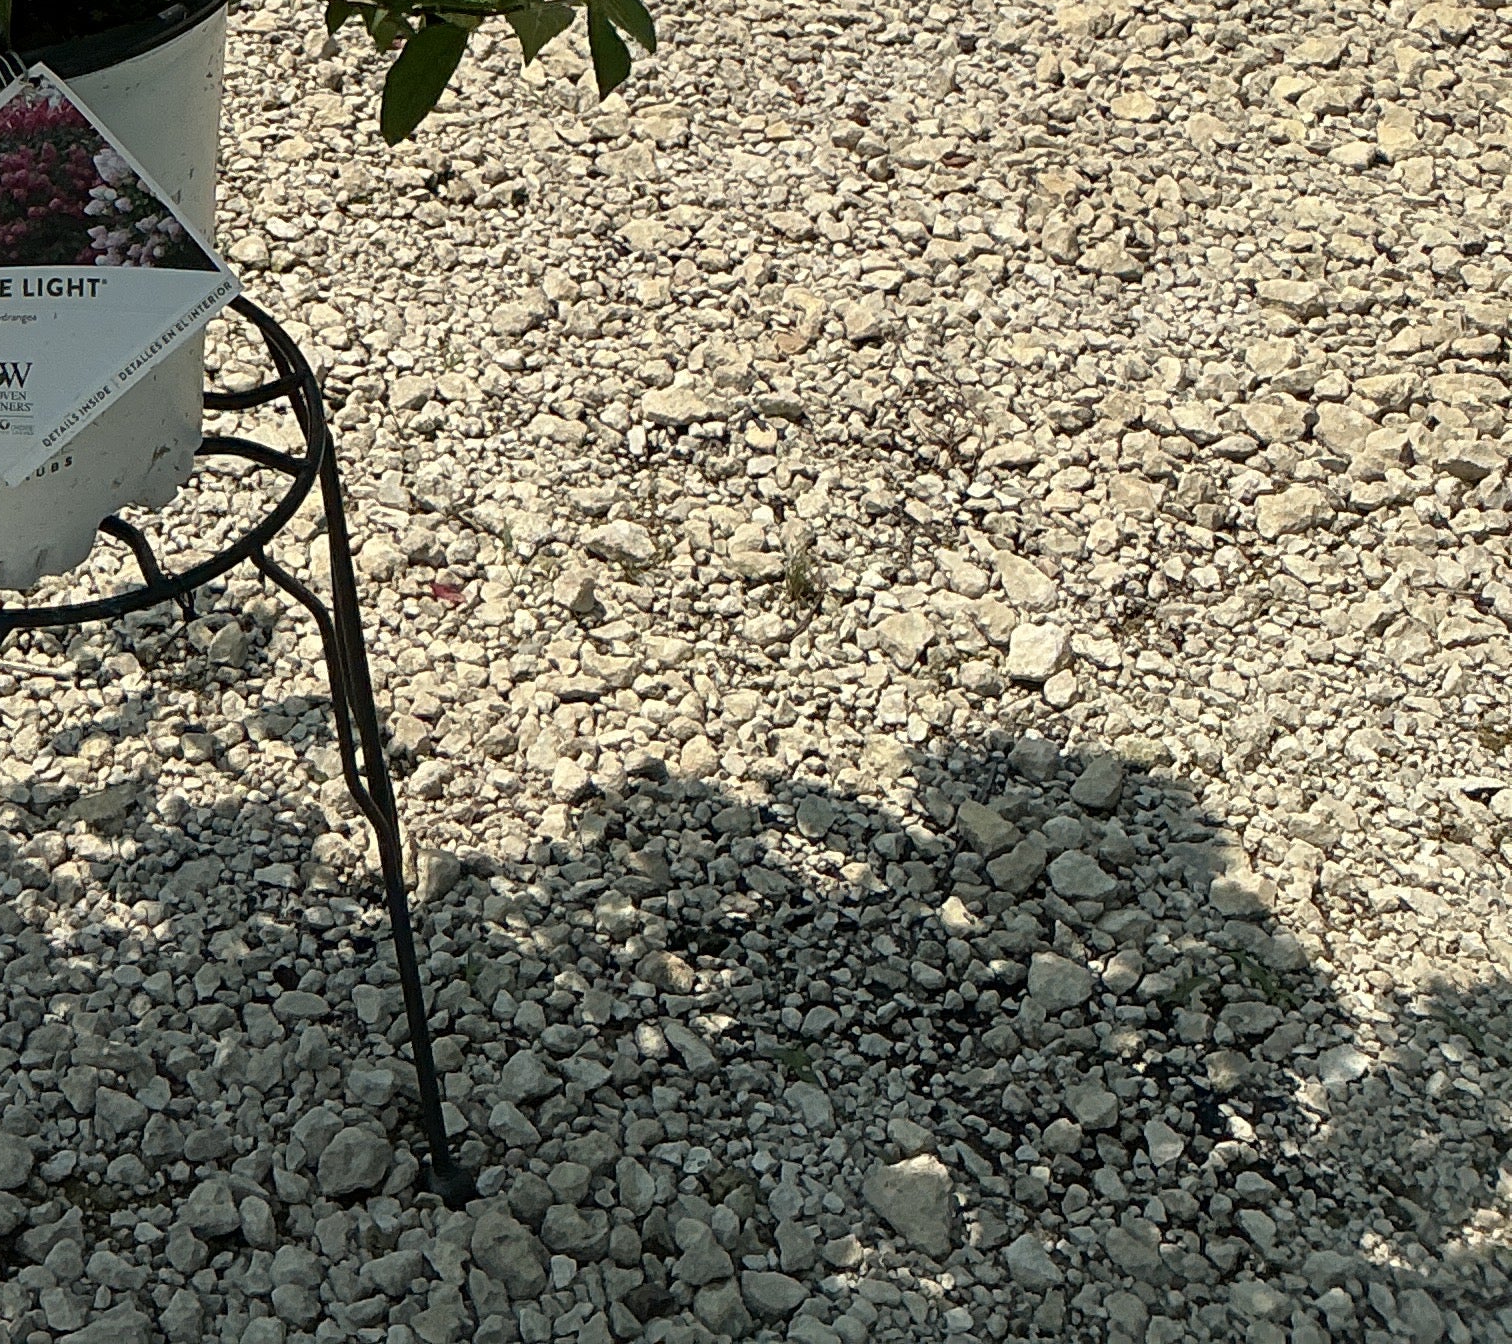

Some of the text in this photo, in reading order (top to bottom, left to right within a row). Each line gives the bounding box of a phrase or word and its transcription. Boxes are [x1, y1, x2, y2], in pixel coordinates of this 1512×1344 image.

[42, 413, 80, 448] DETAILS
[79, 384, 112, 417] INSIDE
[118, 341, 163, 382] DETALLES
[162, 328, 178, 345] EN
[175, 316, 190, 333] EL
[188, 280, 233, 322] INTERIOR
